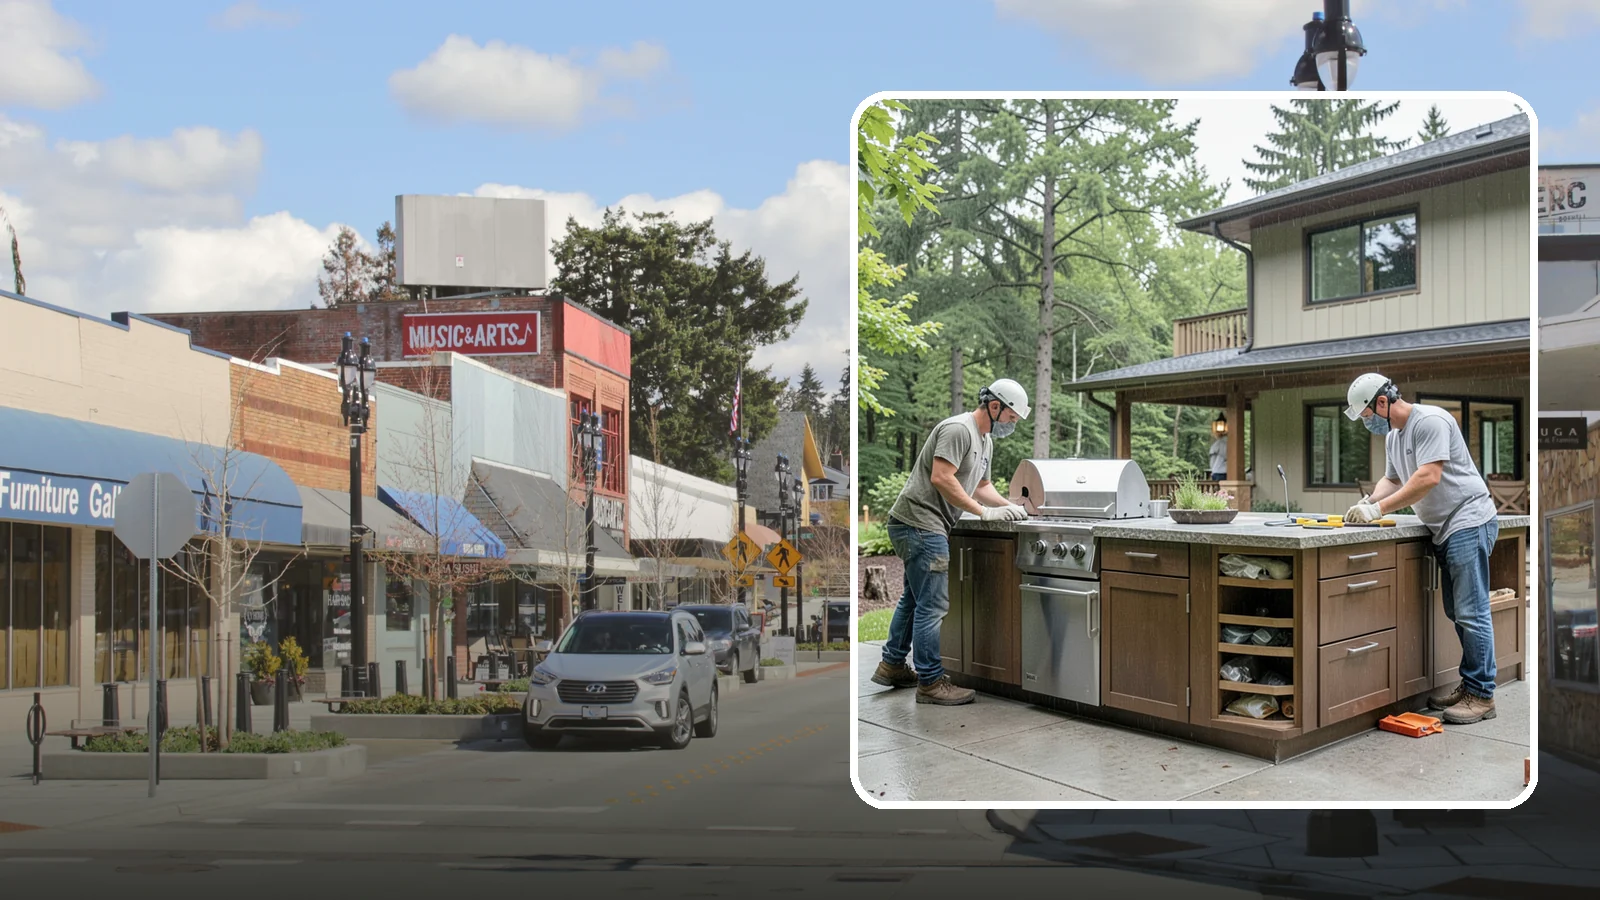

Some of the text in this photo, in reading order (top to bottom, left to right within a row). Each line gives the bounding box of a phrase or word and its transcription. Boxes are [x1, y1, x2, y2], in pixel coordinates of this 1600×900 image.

[409, 322, 519, 349] MUSIC&ARTS
[1540, 427, 1577, 436] UGA
[0, 471, 121, 519] Furniture Gal
